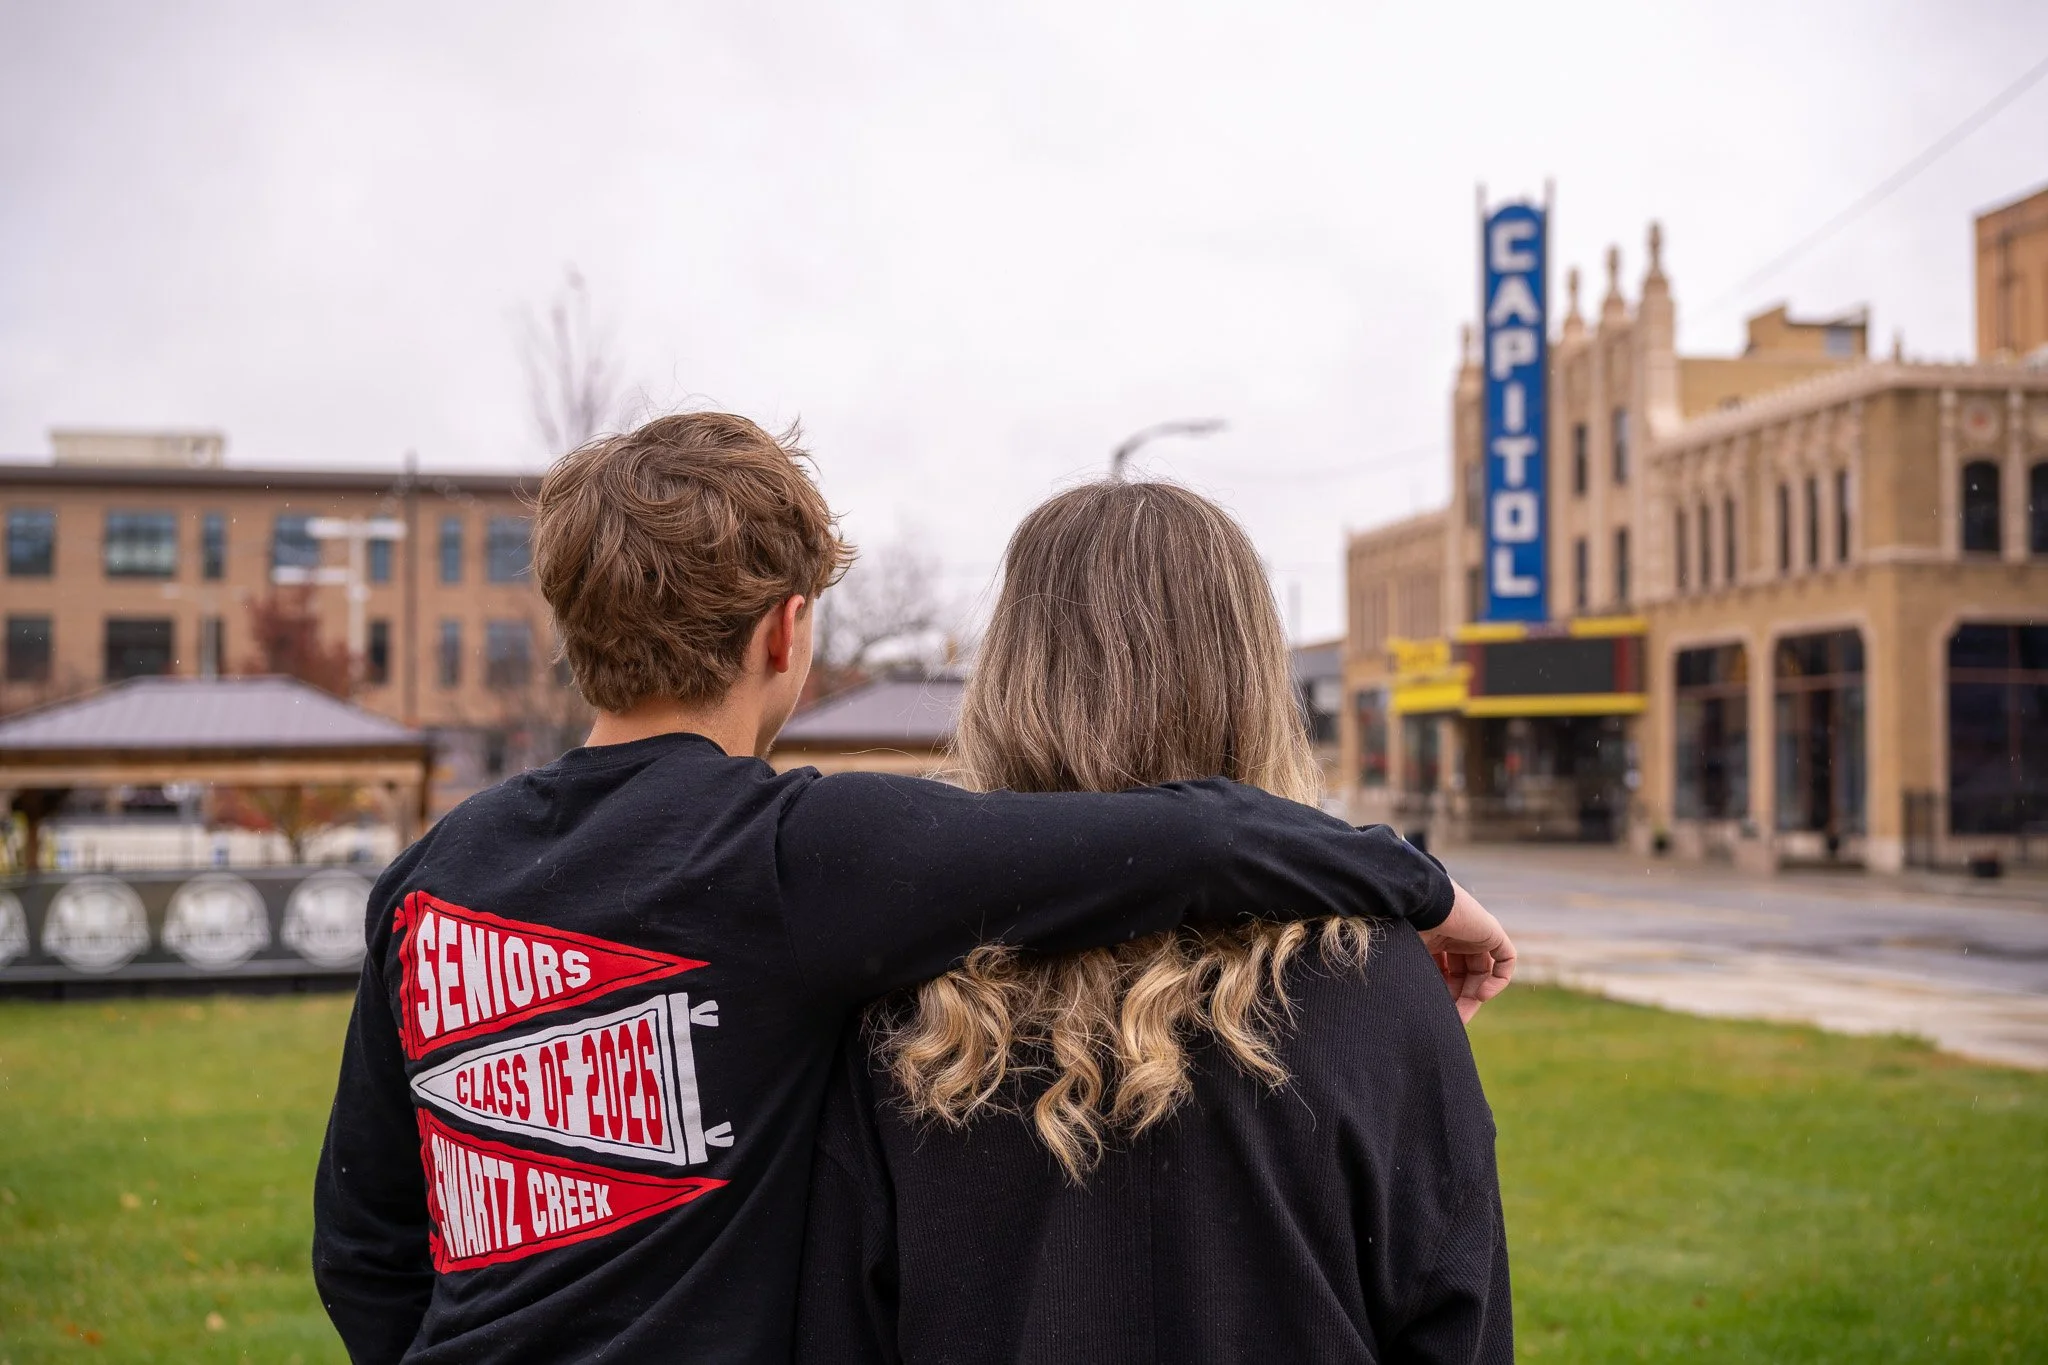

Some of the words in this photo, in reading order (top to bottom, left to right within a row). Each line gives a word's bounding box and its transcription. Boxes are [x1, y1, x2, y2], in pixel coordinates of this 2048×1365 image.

[1489, 219, 1540, 598] CAPITOL
[416, 912, 591, 1038] SENIORS
[456, 1053, 531, 1121] CLASS
[539, 1041, 574, 1130] OF
[582, 1019, 663, 1145] 2026
[432, 1133, 522, 1258] SWARTZ
[527, 1168, 613, 1237] CREEK
